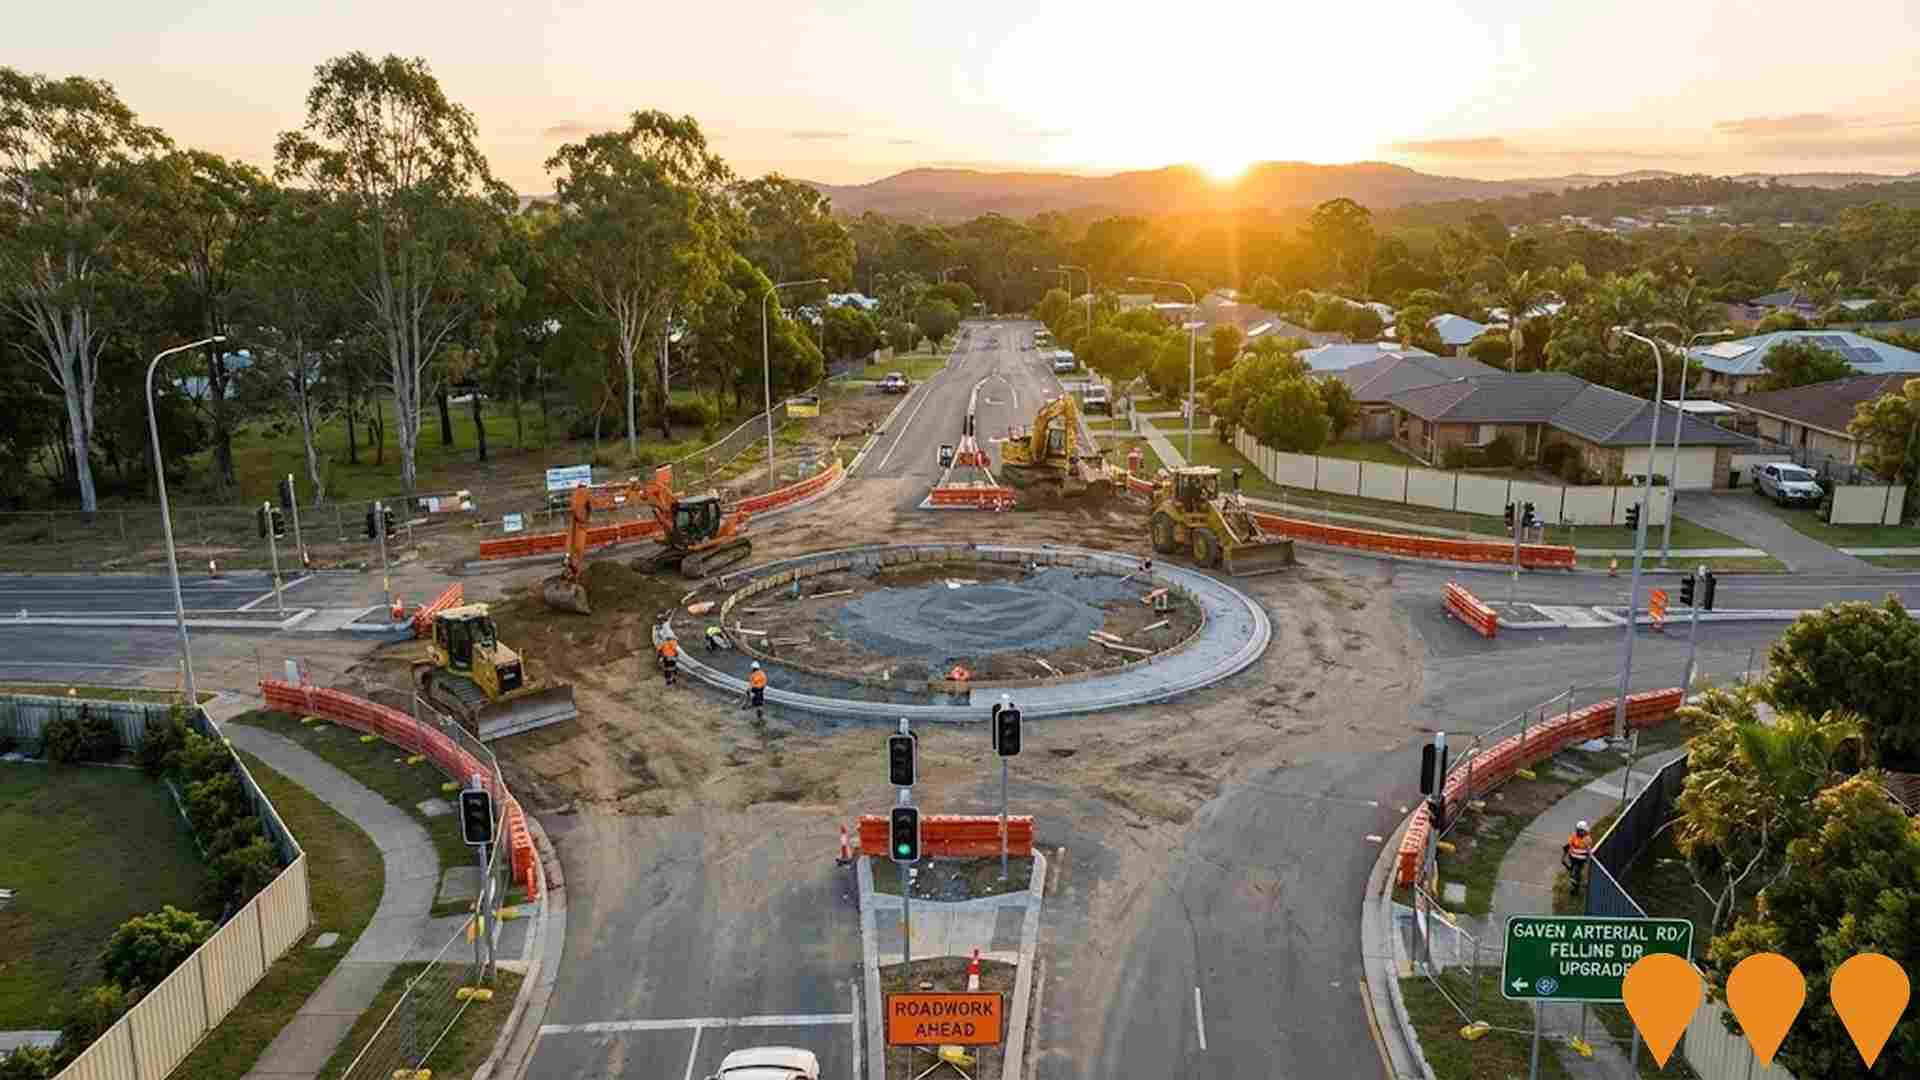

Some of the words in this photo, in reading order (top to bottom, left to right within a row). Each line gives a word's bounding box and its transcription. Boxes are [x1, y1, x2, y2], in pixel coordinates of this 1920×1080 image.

[1513, 923, 1566, 938] GAVEN
[1572, 925, 1648, 941] ARTERIAL
[1656, 926, 1687, 942] RD/
[1550, 942, 1614, 958] FELLING
[1621, 944, 1643, 959] DR
[895, 1001, 993, 1017] ROADWORK
[916, 1022, 975, 1037] AHEAD
